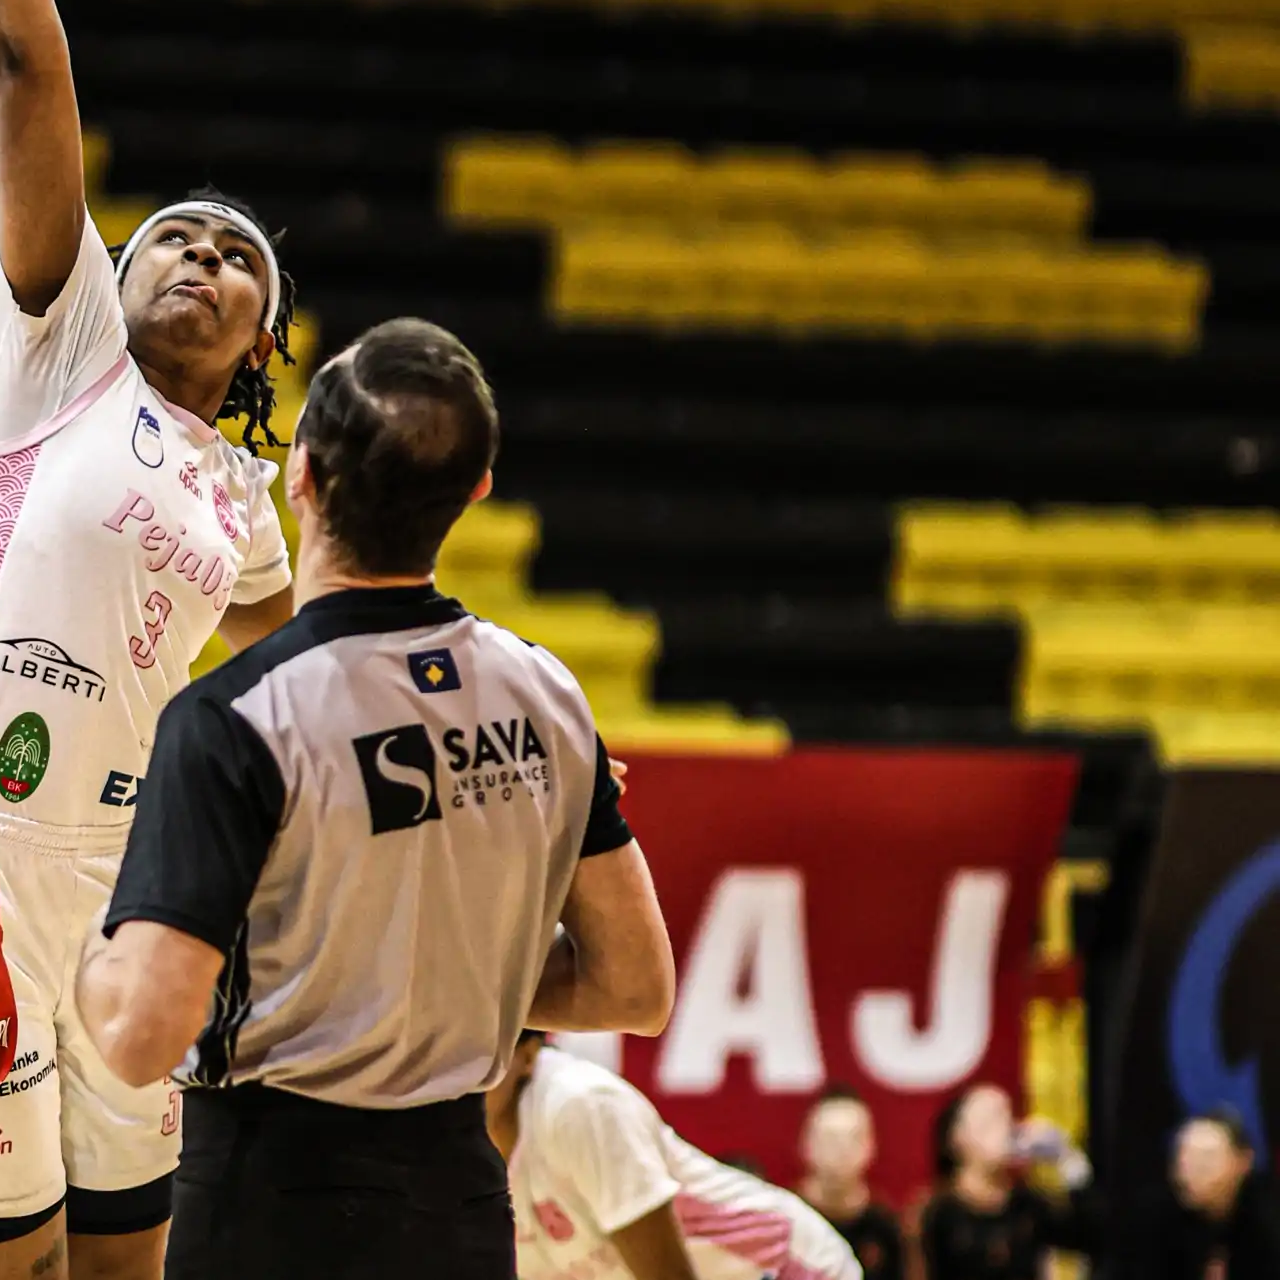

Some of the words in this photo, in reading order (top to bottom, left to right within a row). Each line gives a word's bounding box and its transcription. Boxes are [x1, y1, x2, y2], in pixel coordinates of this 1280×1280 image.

[129, 590, 172, 669] 3
[27, 643, 57, 656] AUTO
[442, 716, 548, 772] SAVA
[7, 780, 22, 792] BK
[553, 866, 1011, 1097] AJ
[9, 1050, 39, 1072] anka
